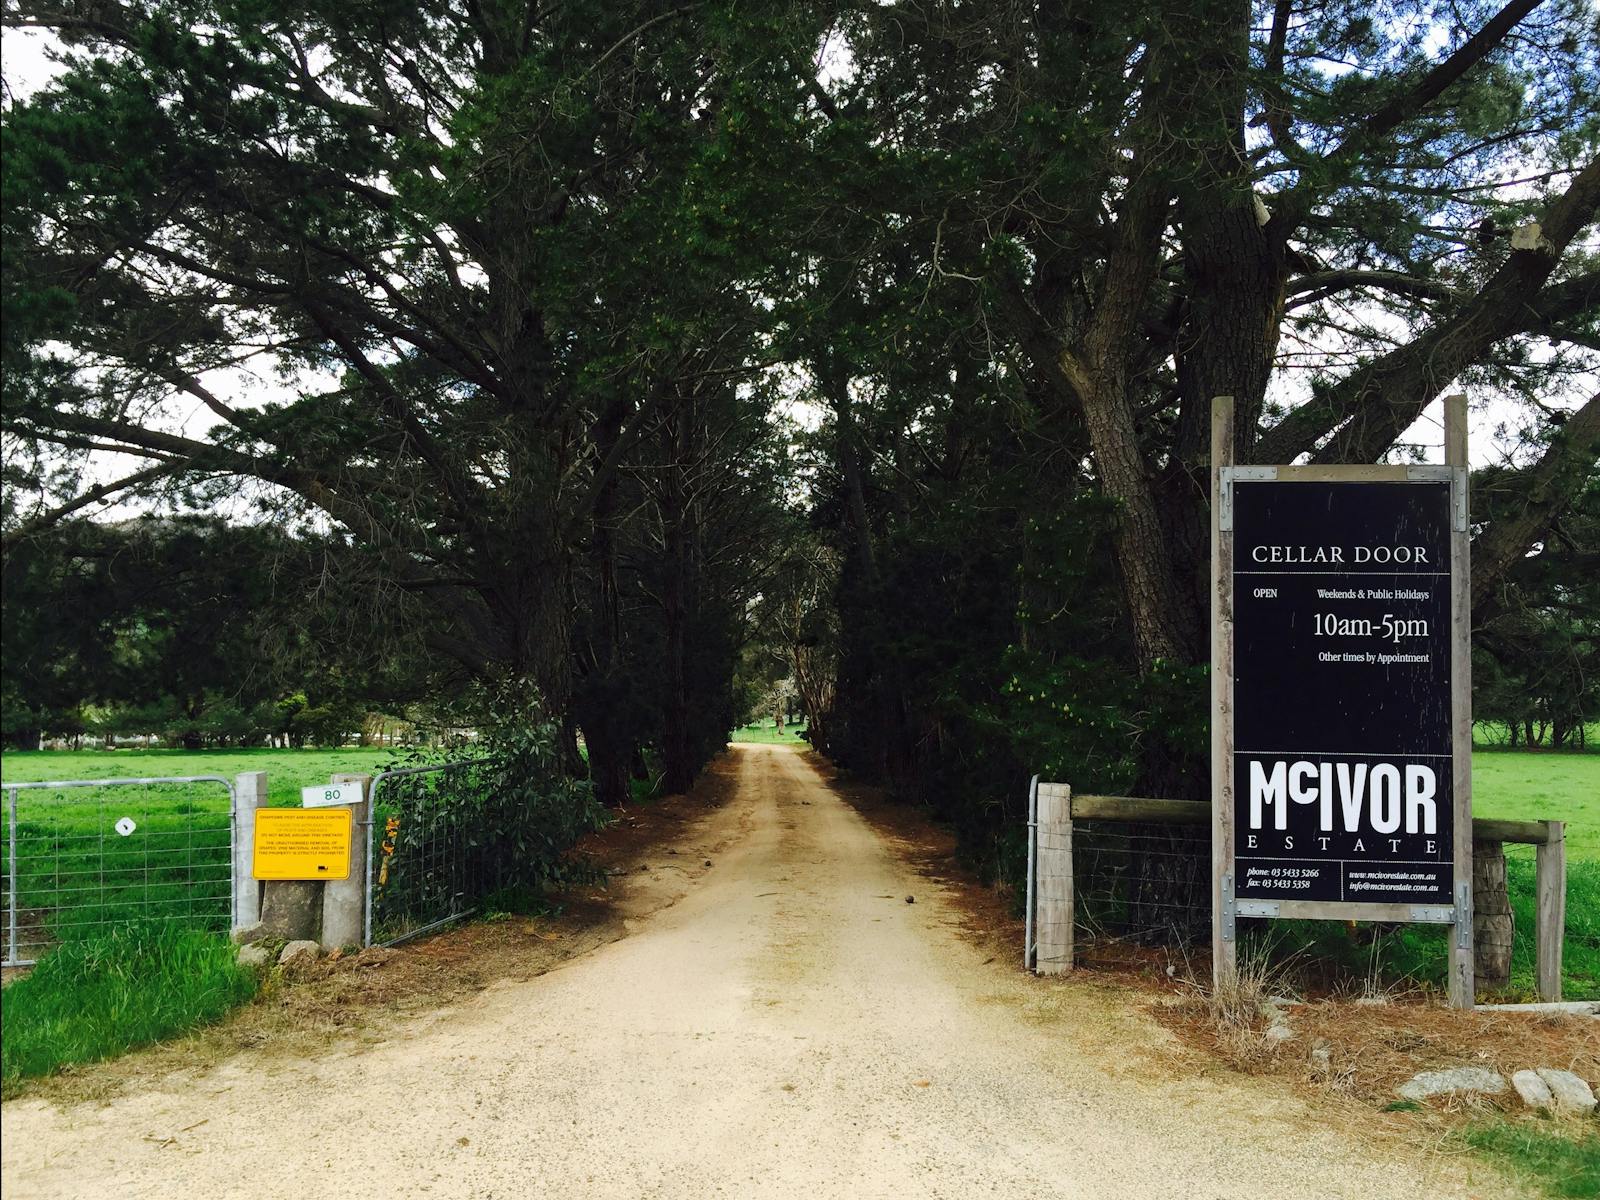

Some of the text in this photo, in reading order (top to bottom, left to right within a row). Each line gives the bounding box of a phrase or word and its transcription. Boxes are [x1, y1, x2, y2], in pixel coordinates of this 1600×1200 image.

[1252, 546, 1429, 563] CELLAR DOOR
[1253, 588, 1278, 598] OPEN
[1317, 589, 1429, 601] Weekends & Public Holidays
[1313, 613, 1429, 643] 10am-5pm
[1318, 652, 1429, 664] Other times by Appointment
[325, 790, 341, 800] 80
[1250, 760, 1437, 835] McIVOR
[1247, 835, 1437, 854] ESTATE
[1246, 867, 1320, 877] phone: 03 5433 5266
[1348, 871, 1437, 880] www.mcivorestate.com.au
[1246, 878, 1311, 889] fax: 03 5433 5358
[1348, 881, 1440, 891] info@mcivorestate.com.au
